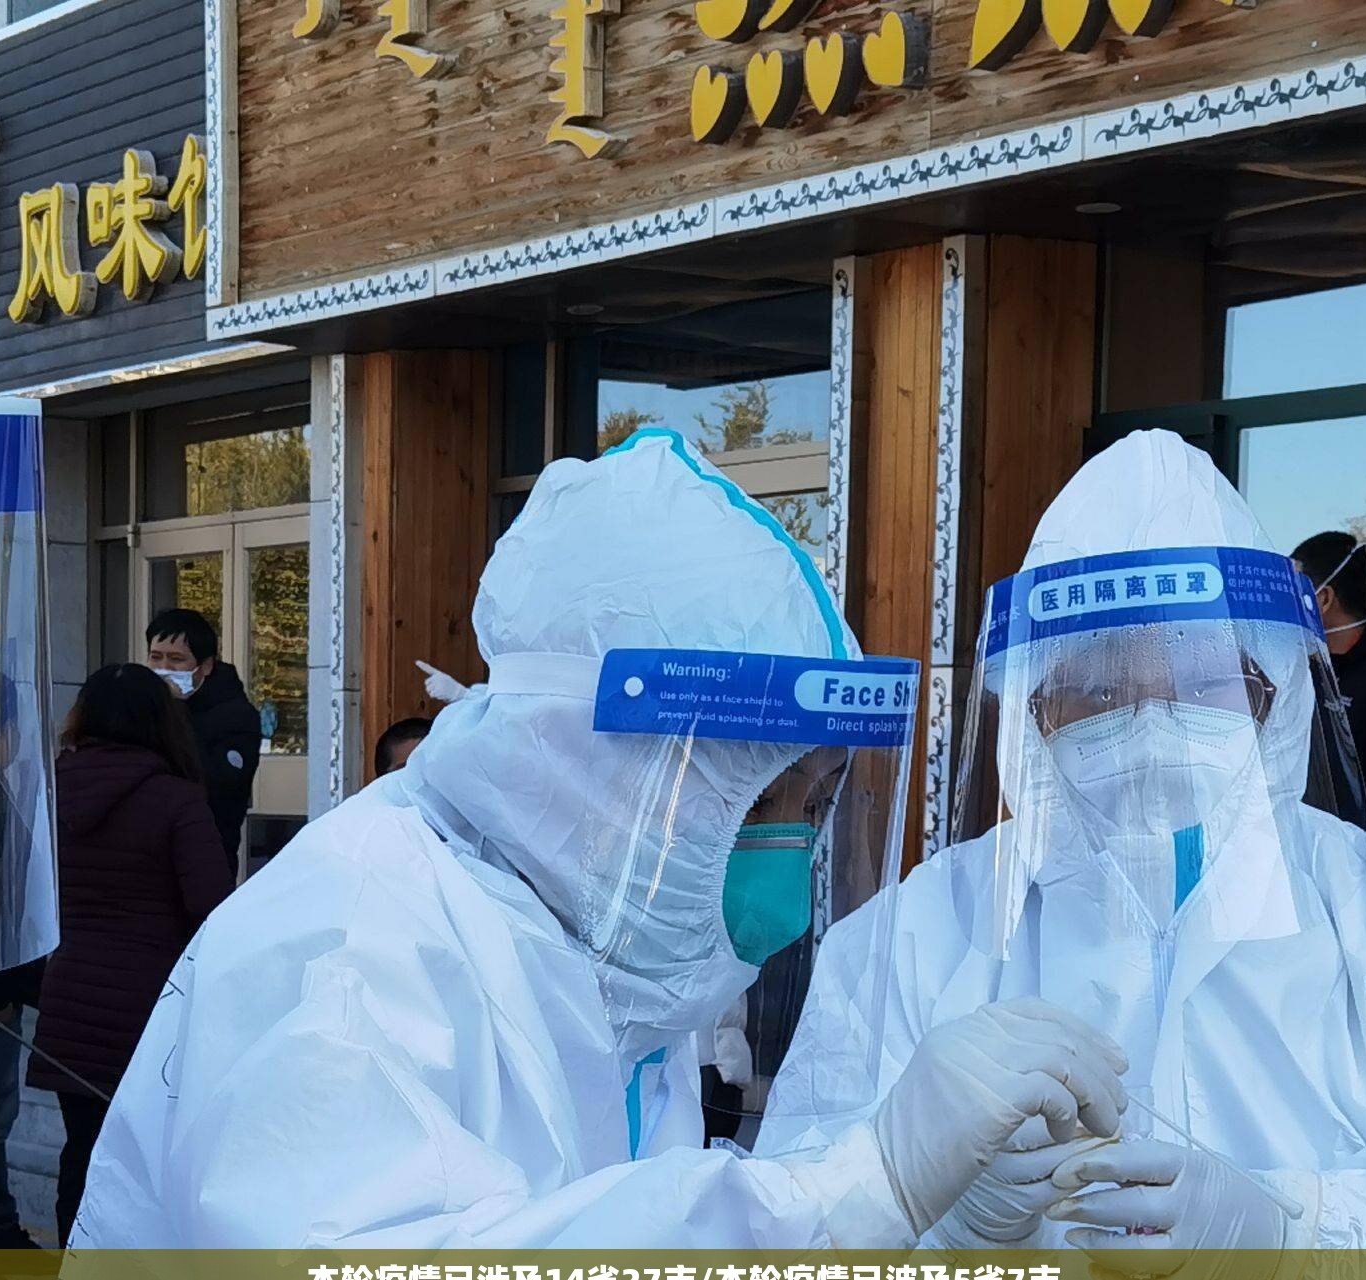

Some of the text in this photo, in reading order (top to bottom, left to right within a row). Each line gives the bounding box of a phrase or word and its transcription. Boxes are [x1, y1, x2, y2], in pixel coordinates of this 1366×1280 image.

[1041, 571, 1209, 612] 医用隔离面罩
[662, 662, 731, 682] Warning:
[679, 692, 698, 703] only
[723, 695, 741, 704] face
[744, 694, 771, 706] shield
[823, 678, 885, 706] Face
[658, 711, 692, 720] prevent
[719, 714, 763, 727] splashing
[827, 717, 864, 731] Direct
